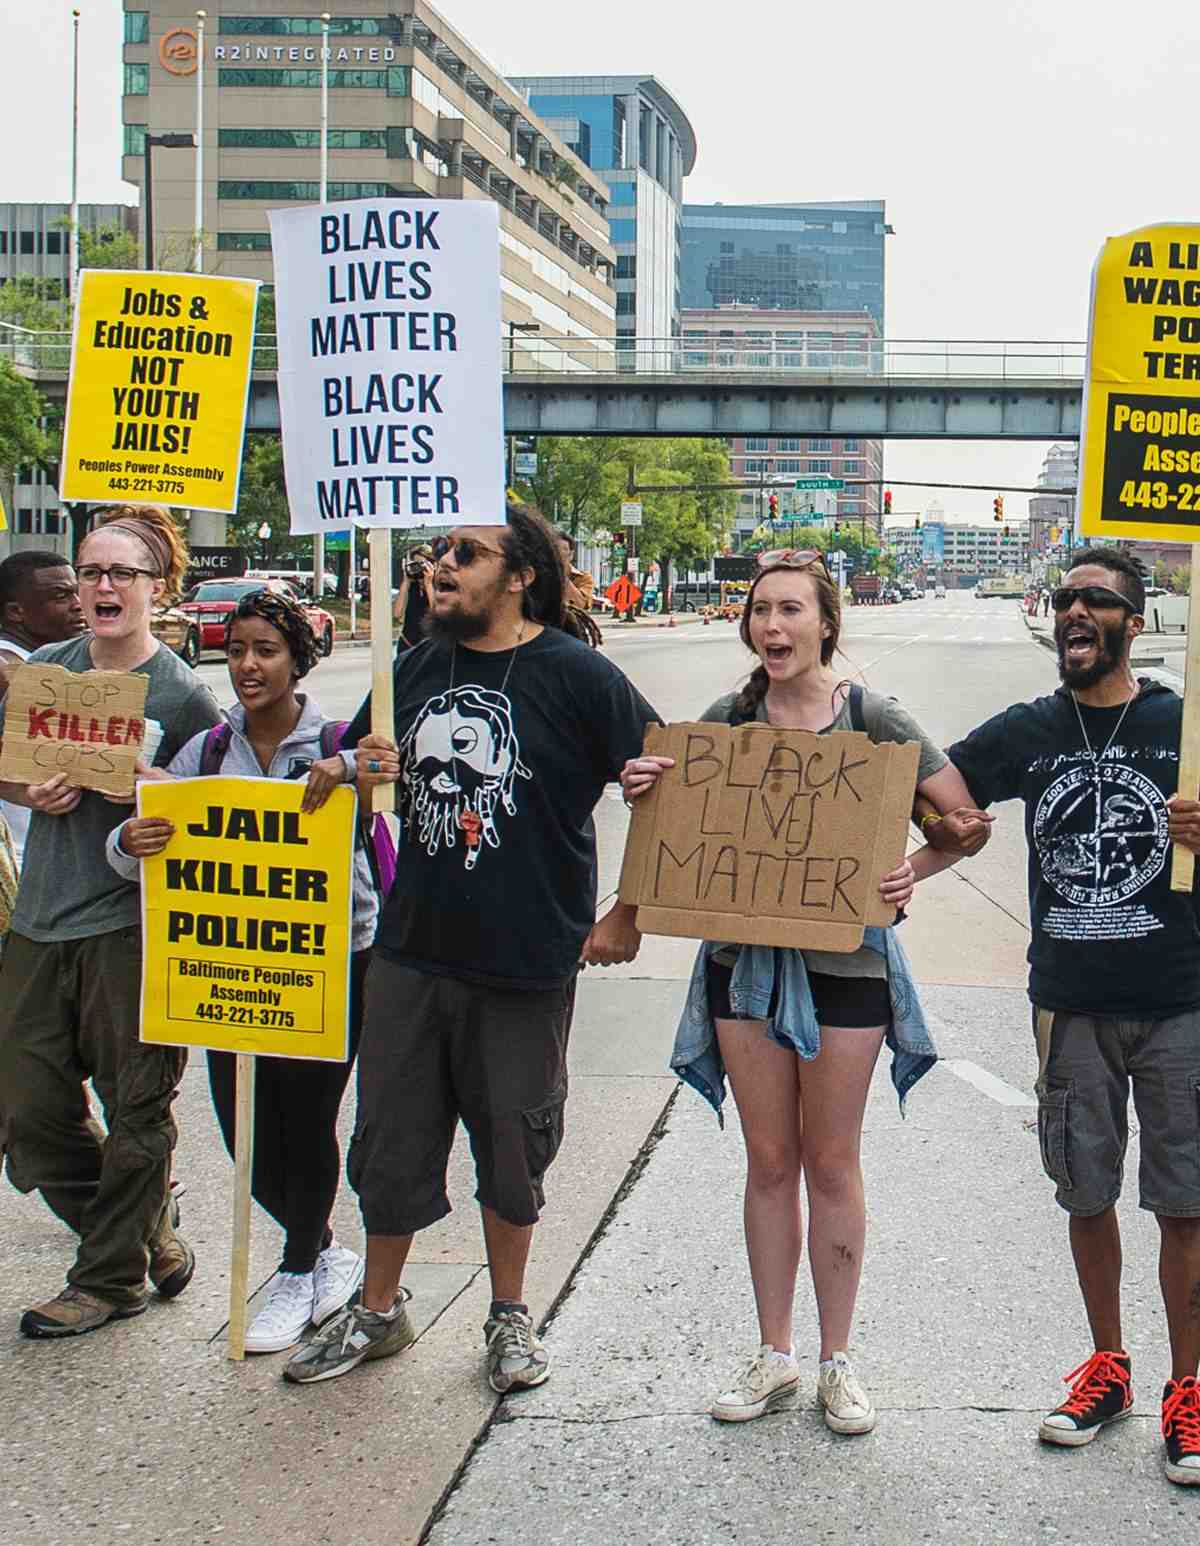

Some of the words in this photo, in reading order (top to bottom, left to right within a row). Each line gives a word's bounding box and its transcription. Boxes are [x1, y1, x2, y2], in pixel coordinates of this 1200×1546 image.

[320, 209, 441, 254] BLACK
[1129, 241, 1153, 267] A
[328, 260, 432, 304] LIVES
[120, 287, 181, 318] Jobs
[189, 296, 210, 321] &
[93, 320, 233, 357] Education
[310, 311, 457, 357] MATTER
[131, 356, 184, 386] NOT
[113, 387, 200, 421] YOUTH
[323, 373, 443, 417] BLACK
[112, 422, 192, 455] JAILS!
[332, 424, 435, 468] LIVES
[79, 458, 122, 474] Peoples
[125, 461, 161, 475] Power
[162, 463, 225, 482] Assembly
[108, 477, 185, 495] 443-221-3775
[316, 475, 460, 520] MATTER
[34, 679, 121, 708] STOP
[27, 704, 145, 745] KILLER
[31, 743, 116, 773] COPS
[684, 733, 869, 803] BLACK
[187, 806, 309, 845] JAIL
[700, 788, 821, 857] LIVES
[166, 859, 328, 902] KILLER
[654, 839, 859, 917] MATTER
[168, 910, 326, 956] POLICE!
[179, 961, 249, 983] Baltimore
[253, 969, 314, 988] Peoples
[210, 984, 281, 1006] Assembly
[195, 1003, 295, 1028] 443-221-3775
